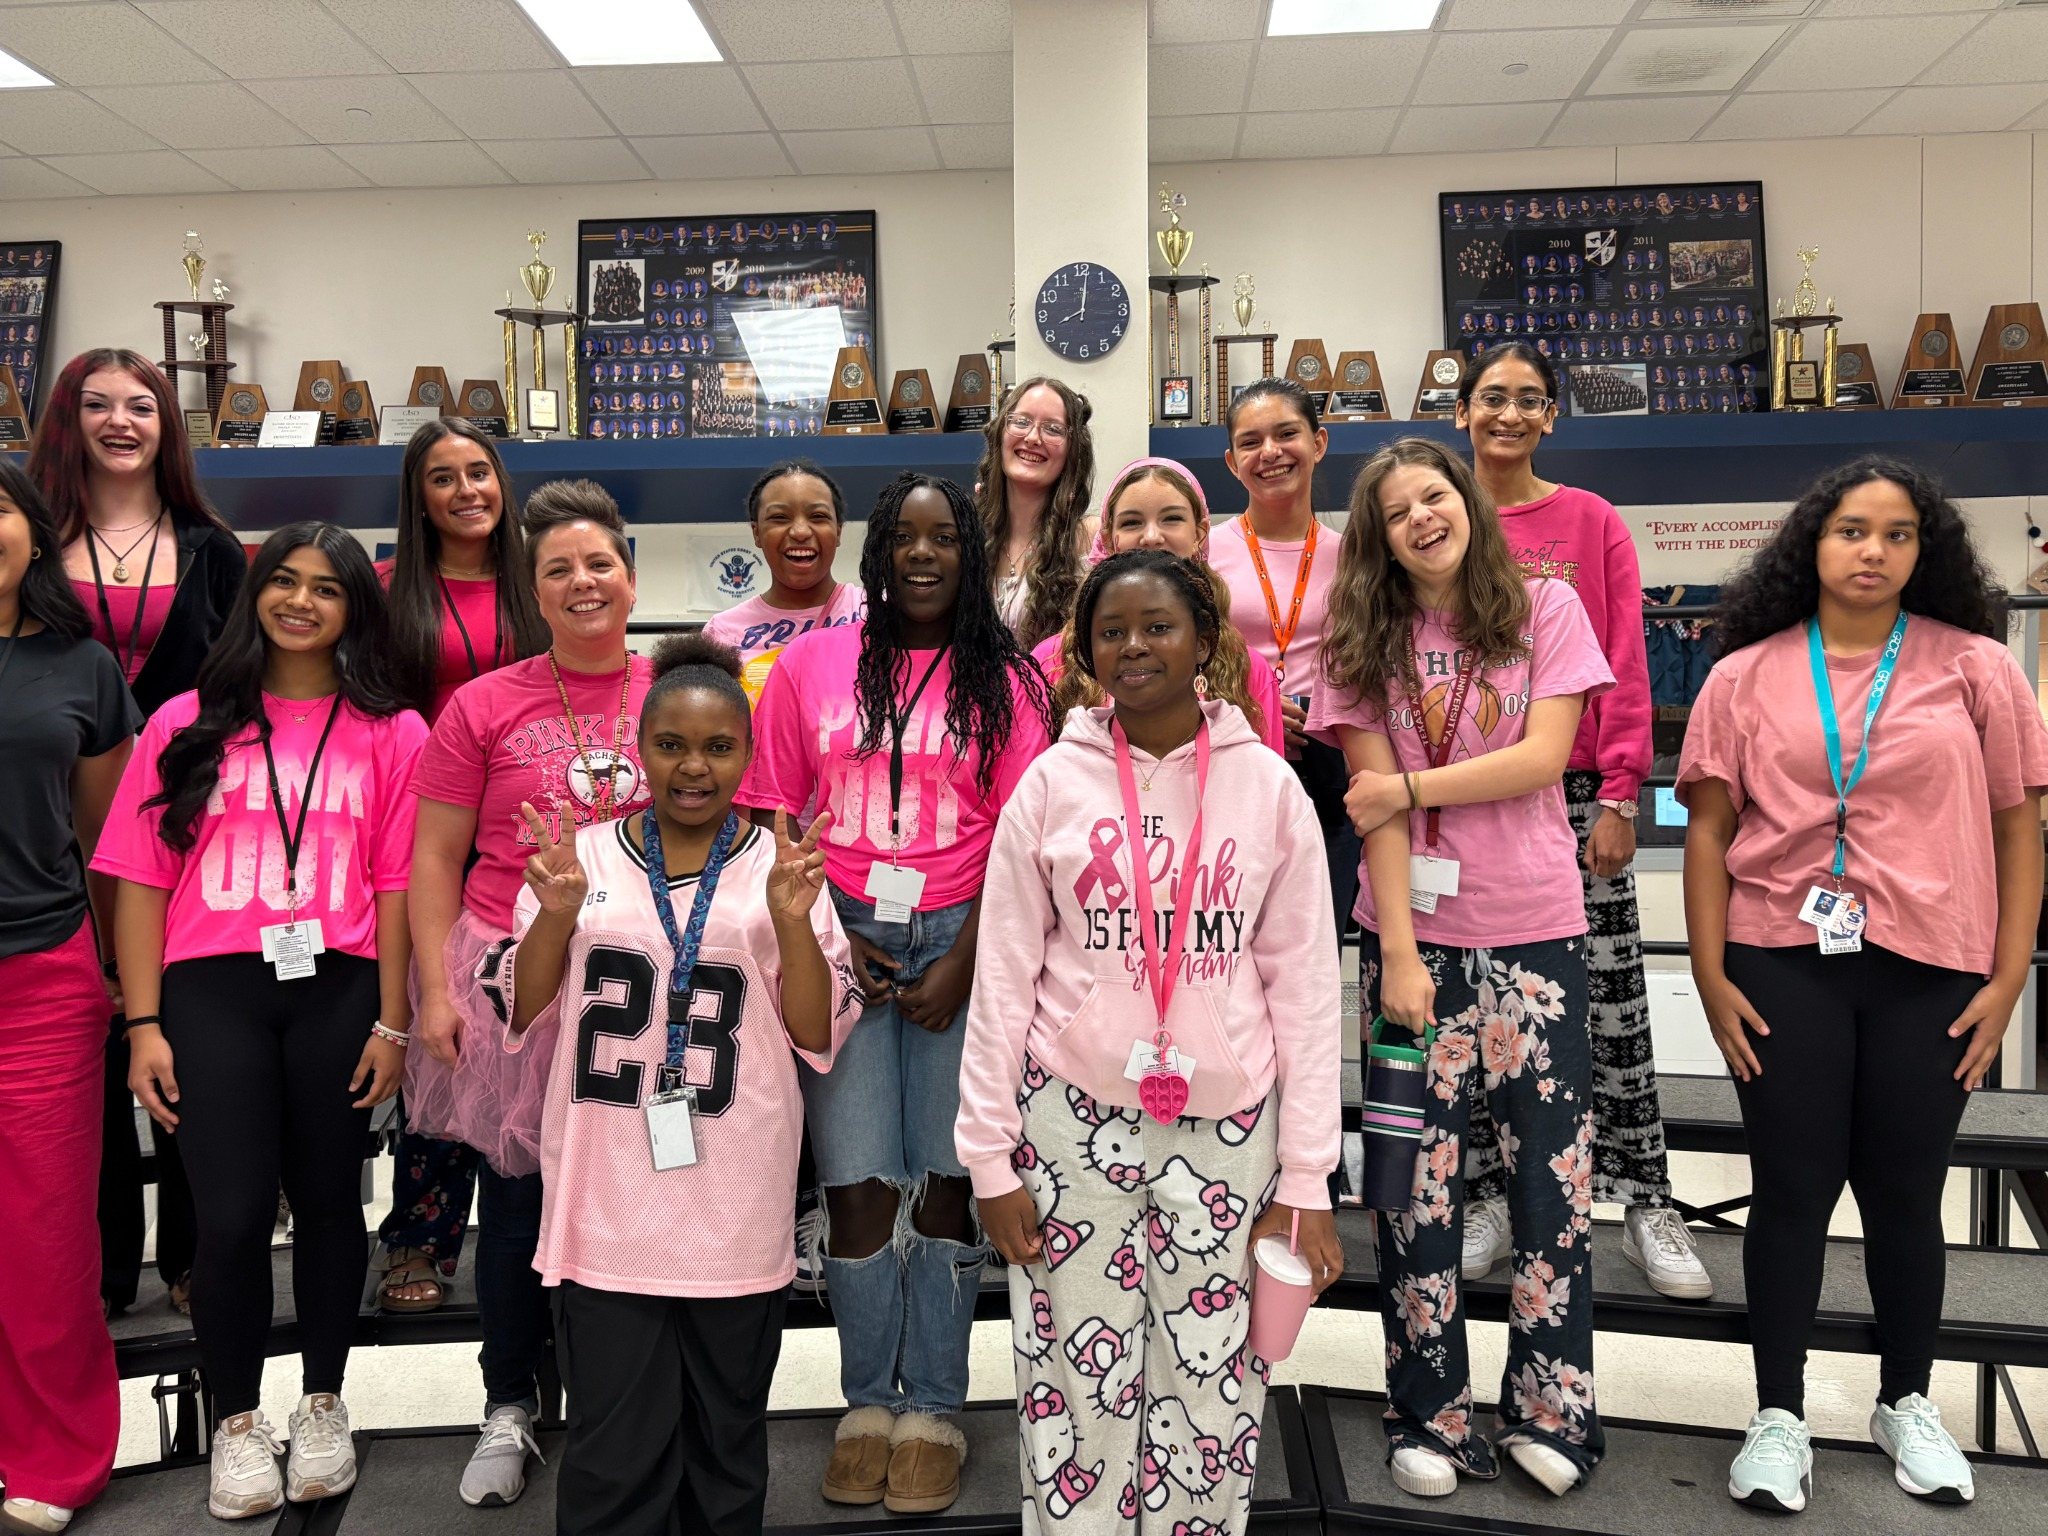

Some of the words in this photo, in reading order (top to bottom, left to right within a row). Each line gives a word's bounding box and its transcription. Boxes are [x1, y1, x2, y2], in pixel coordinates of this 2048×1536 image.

[1548, 239, 1570, 248] 2010
[1633, 236, 1654, 245] 2011
[685, 266, 706, 276] 2009
[744, 264, 765, 274] 2010
[1073, 263, 1090, 277] 12
[1098, 270, 1106, 284] 1
[1053, 272, 1070, 287] 11
[1041, 289, 1058, 303] 10
[1111, 284, 1121, 298] 2
[1037, 309, 1048, 323] 9
[1117, 303, 1128, 317] 3
[1045, 329, 1056, 343] 8
[1111, 323, 1122, 337] 4
[1059, 341, 1070, 355] 7
[1079, 344, 1090, 358] 6
[1099, 338, 1110, 352] 5
[1511, 539, 1569, 561] irst
[1655, 540, 1692, 551] WITH
[1696, 539, 1725, 550] THE
[1445, 674, 1468, 738] UNIVERSITY
[1413, 708, 1429, 747] TEXAS
[502, 714, 605, 767] PINK
[206, 750, 373, 819] PINK
[200, 828, 356, 913] OUT
[1083, 908, 1110, 950] IS
[1194, 910, 1245, 953] MY
[571, 944, 748, 1118] 23
